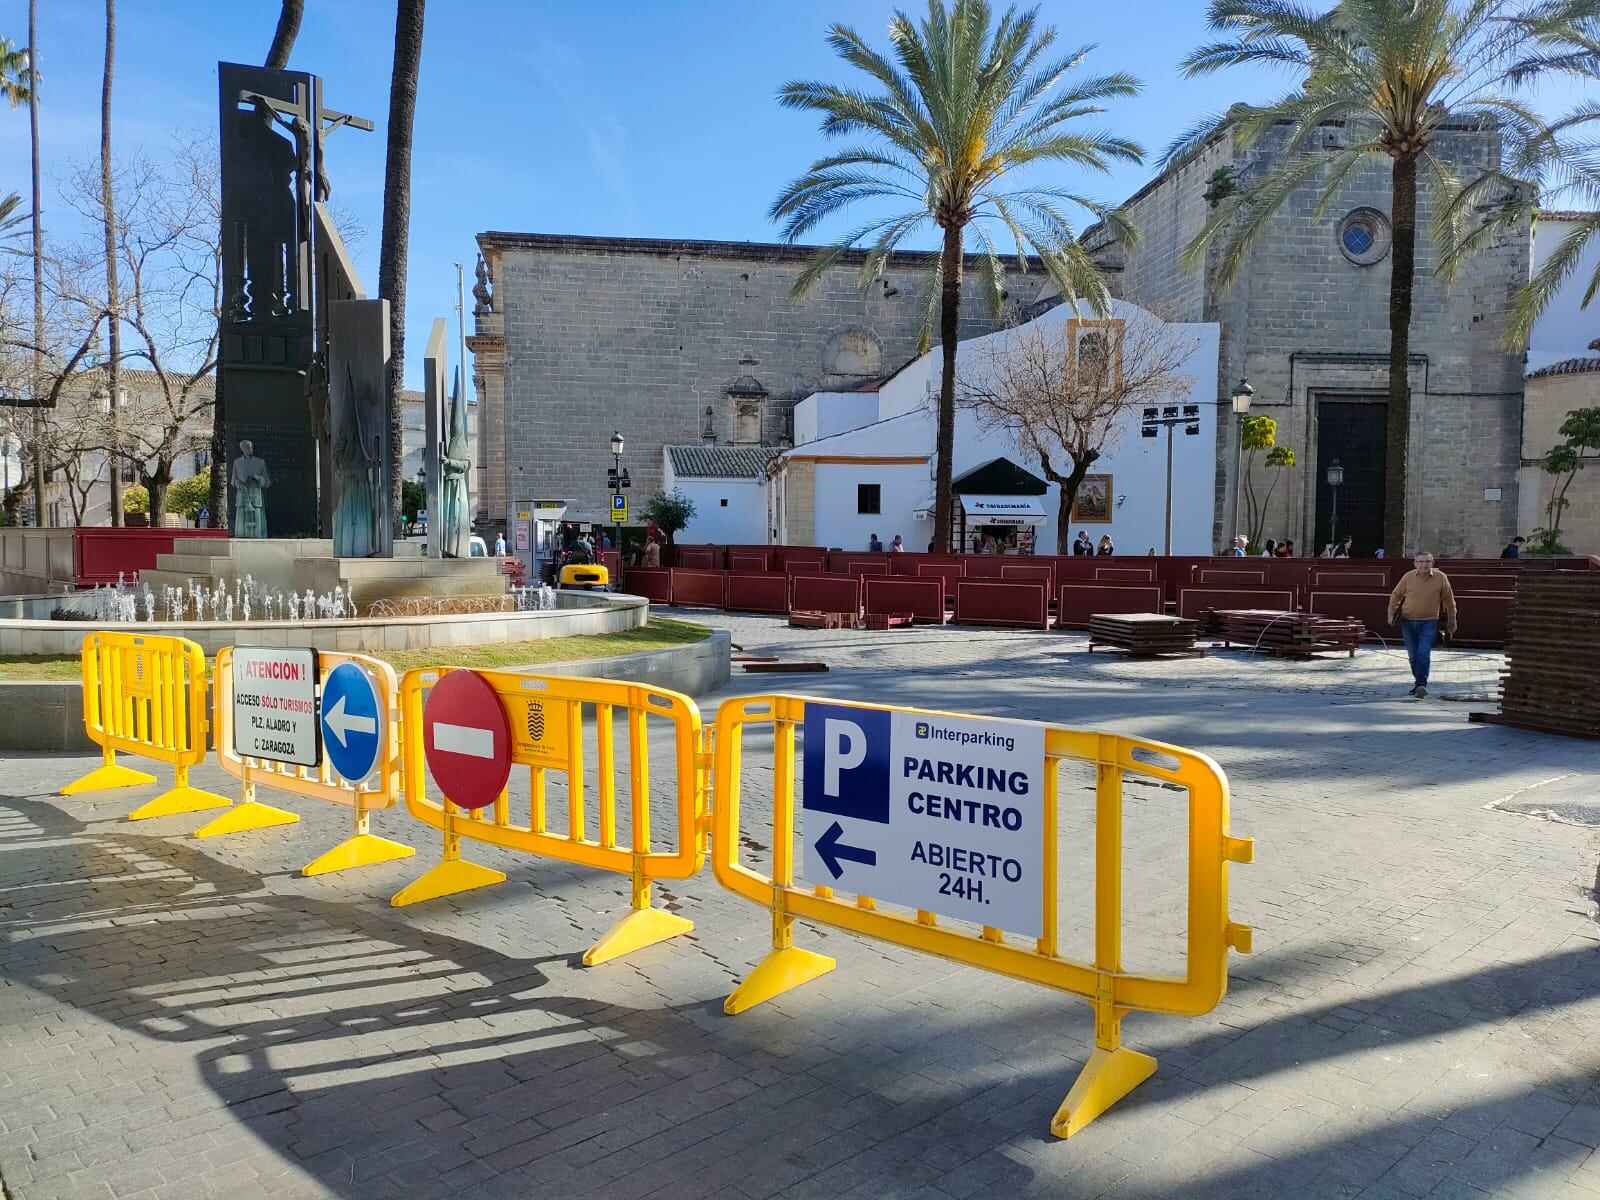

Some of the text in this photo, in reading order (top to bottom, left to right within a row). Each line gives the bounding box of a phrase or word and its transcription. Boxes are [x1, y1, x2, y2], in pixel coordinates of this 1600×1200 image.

[616, 498, 622, 507] P
[245, 658, 299, 681] ATENCIÓN
[236, 693, 313, 714] ACCESO SÓLO TURISMOS
[251, 716, 297, 733] PLZ. ALADRO Y
[261, 739, 296, 756] ZARAGOZA
[930, 725, 1015, 752] Interparking
[823, 717, 867, 798] P
[903, 756, 1030, 796] PARKING
[907, 791, 1023, 832] CENTRO
[910, 841, 1023, 883] ABIERTO
[938, 872, 990, 905] 24H.
